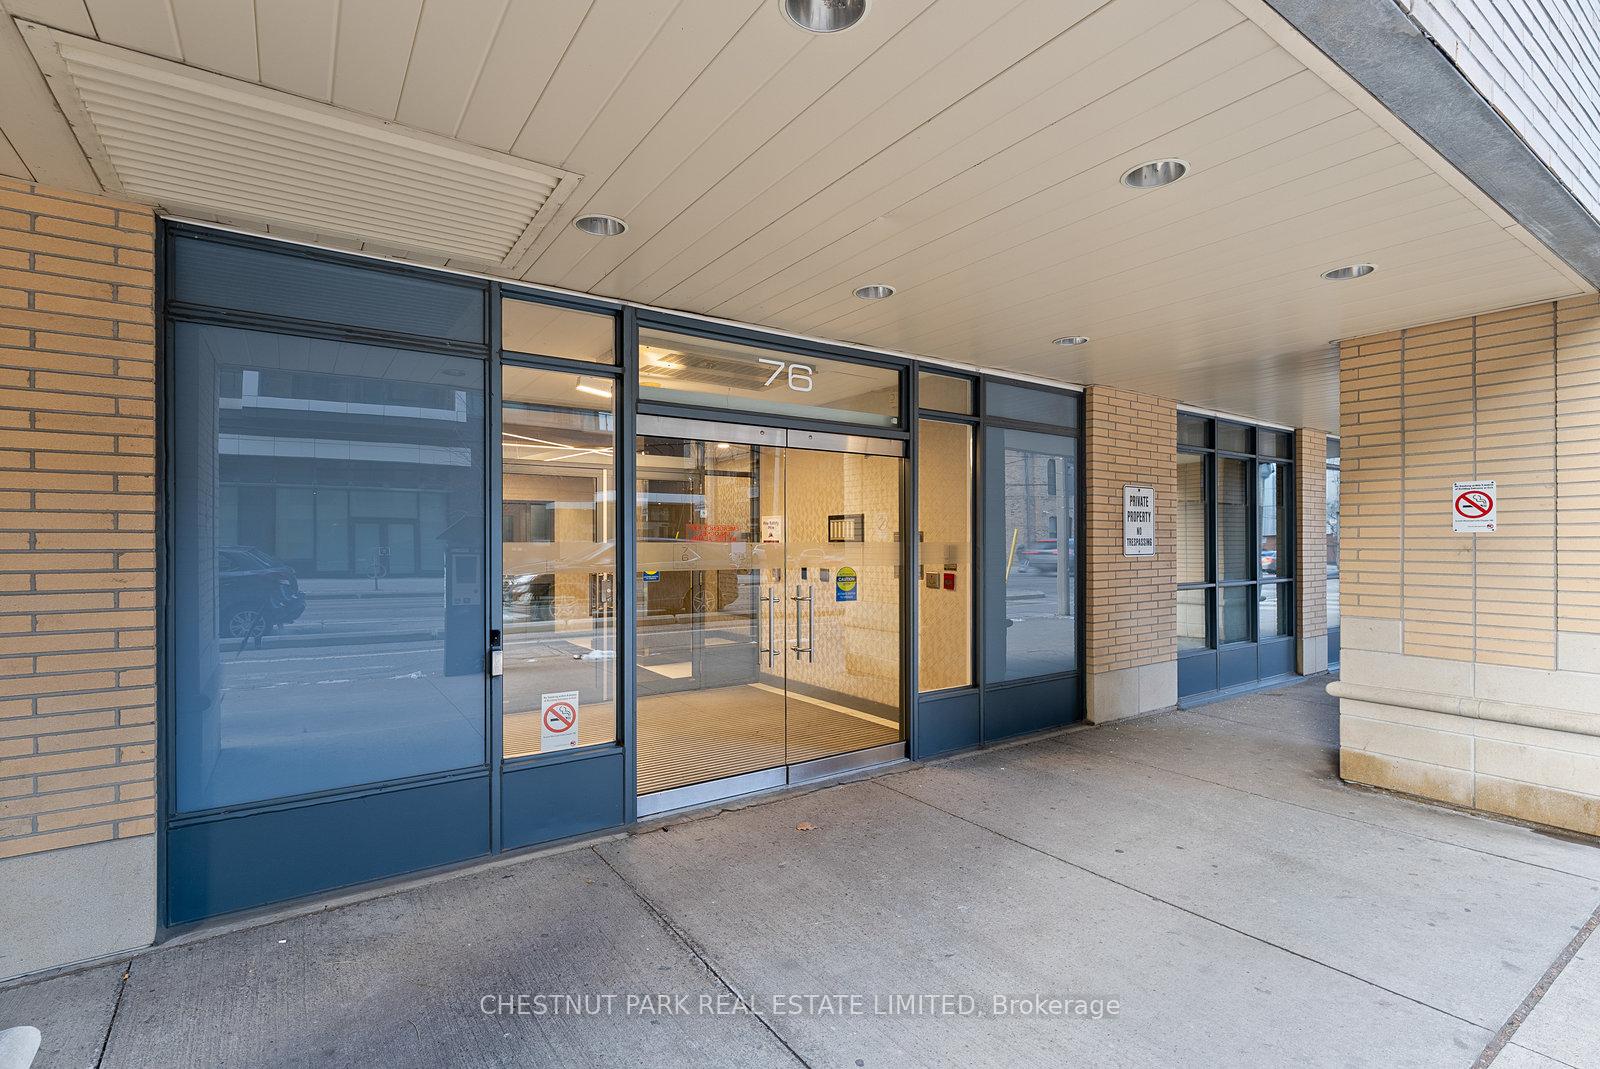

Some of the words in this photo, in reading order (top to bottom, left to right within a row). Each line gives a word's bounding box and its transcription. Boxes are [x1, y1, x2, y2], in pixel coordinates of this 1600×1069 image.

[758, 358, 813, 392] 76
[1130, 495, 1149, 507] PRIVATE
[1127, 510, 1151, 522] PROPERTY
[1136, 527, 1142, 535] NO
[1127, 538, 1152, 546] TRESPASSING
